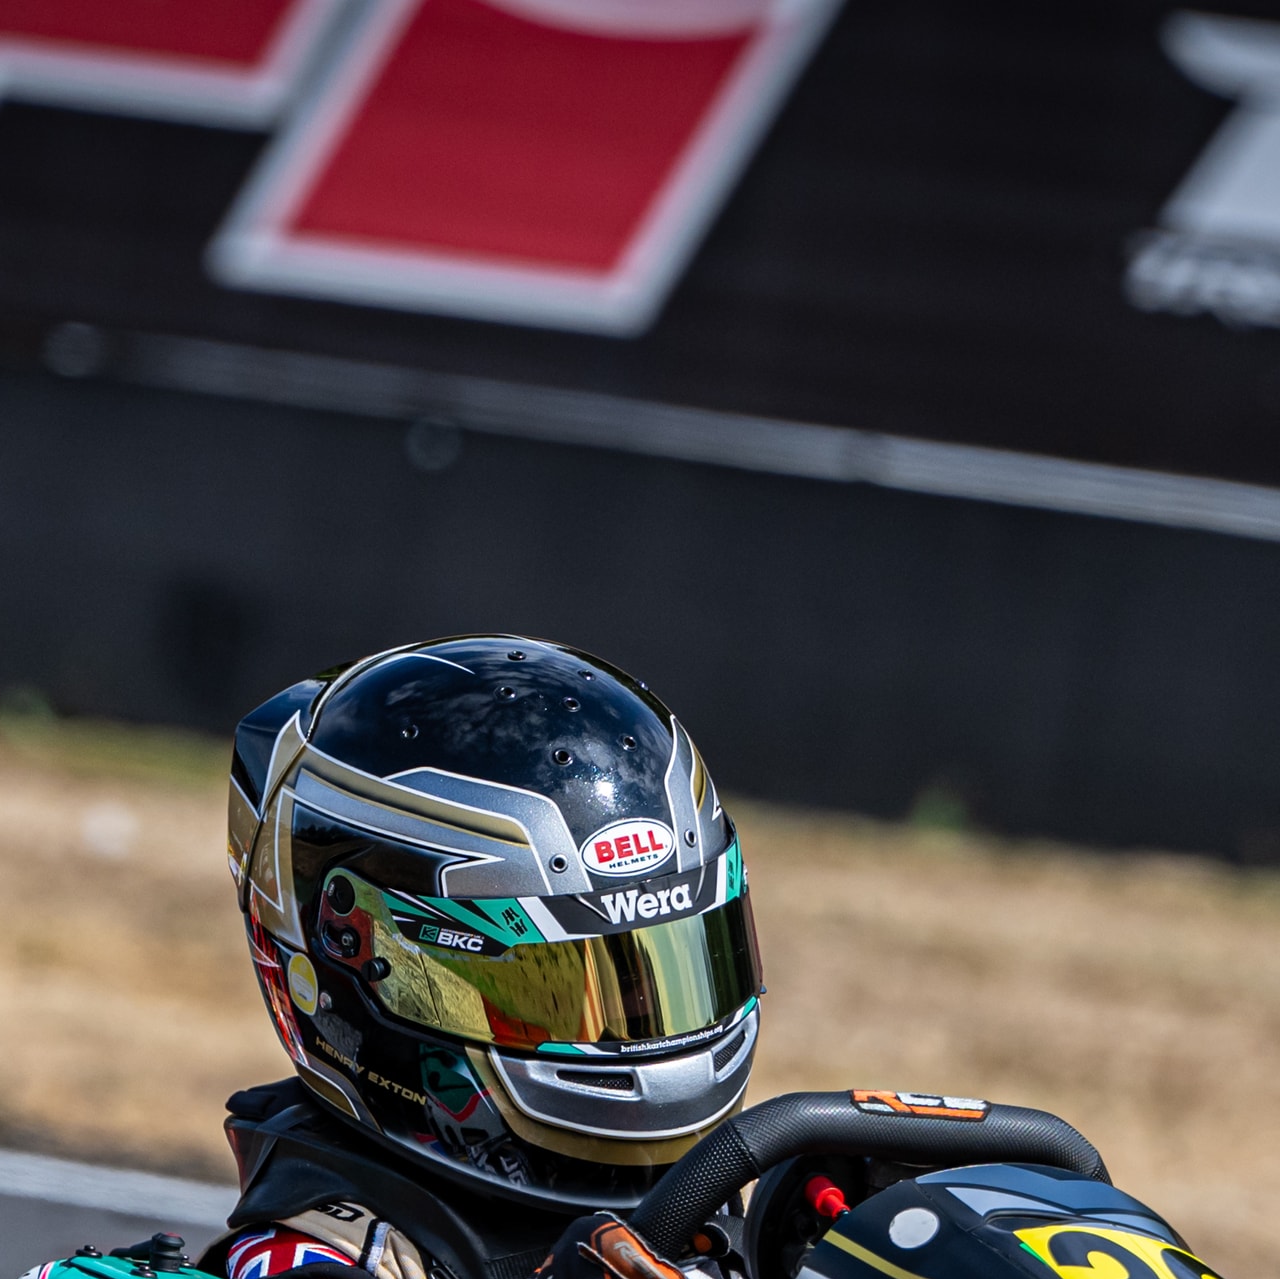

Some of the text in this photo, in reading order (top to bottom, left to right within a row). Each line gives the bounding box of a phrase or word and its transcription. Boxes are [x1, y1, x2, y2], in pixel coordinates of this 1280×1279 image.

[594, 830, 665, 865] BELL
[608, 852, 659, 870] HELMETS
[601, 882, 693, 925] Wera
[437, 931, 484, 952] BKC
[620, 1025, 723, 1054] britishkartchampionships.org
[367, 1071, 427, 1106] EXTON
